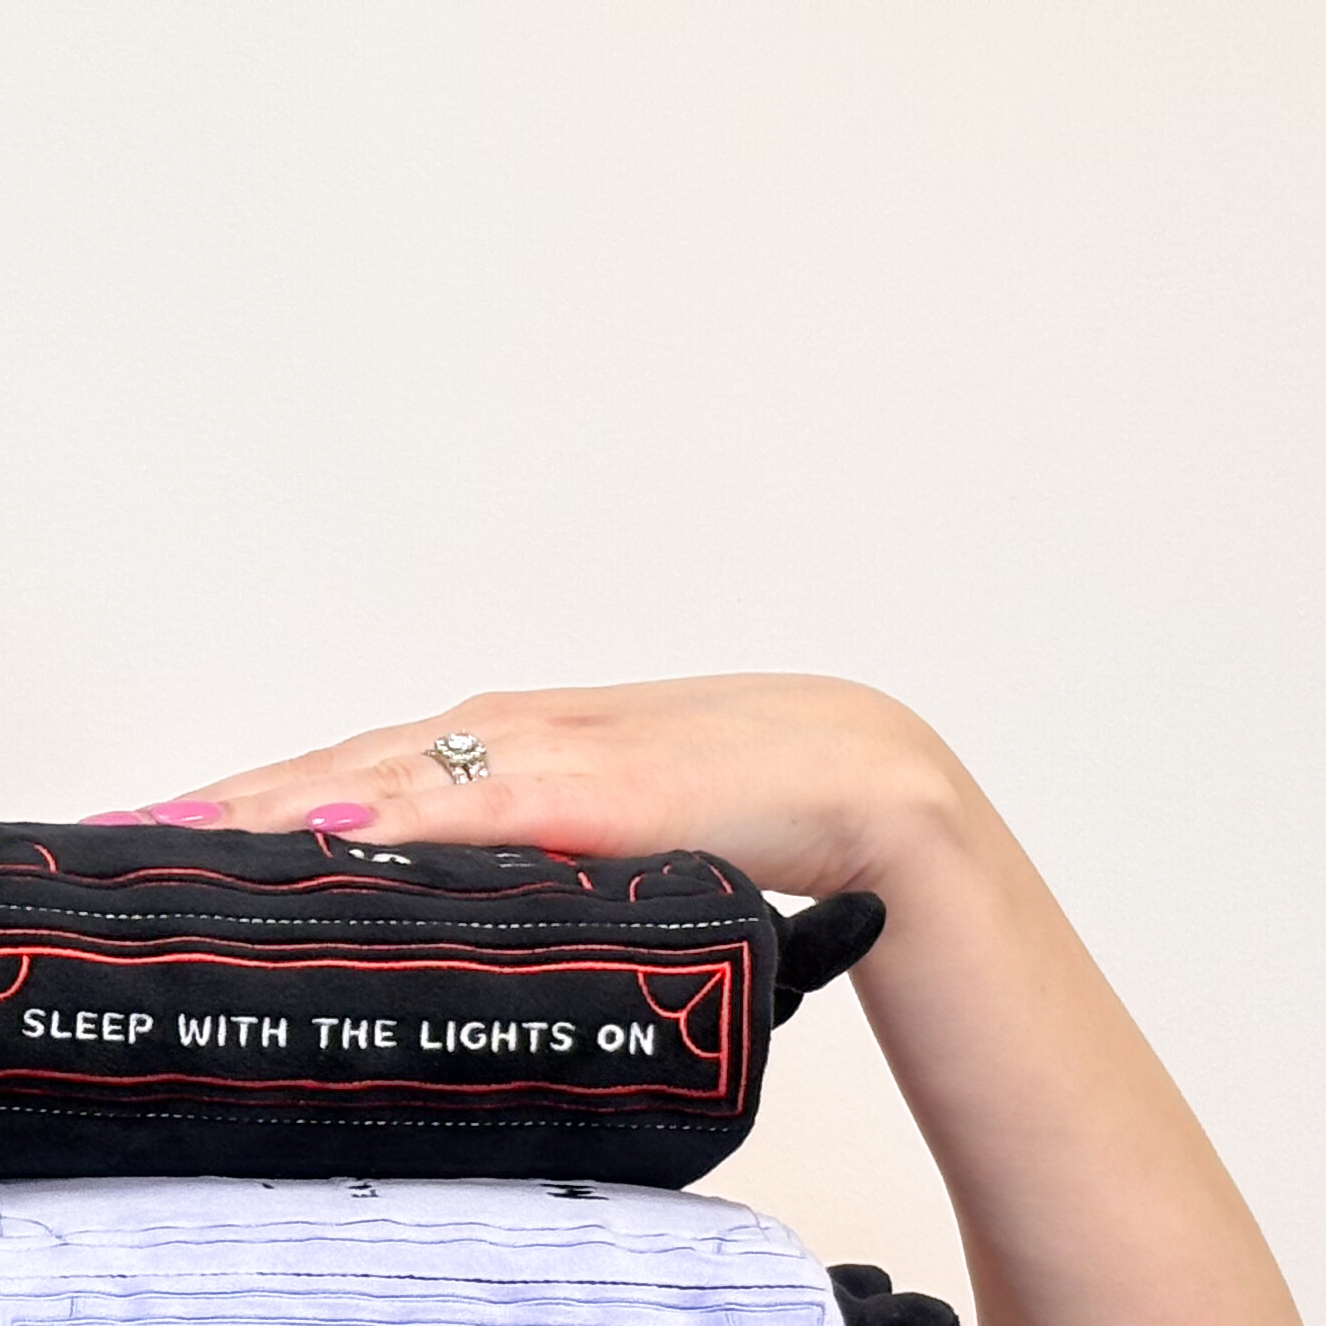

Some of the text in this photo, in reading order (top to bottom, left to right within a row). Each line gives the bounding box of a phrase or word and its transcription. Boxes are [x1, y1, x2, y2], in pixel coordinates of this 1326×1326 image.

[21, 1008, 657, 1058] SLEEP WITH THE LIGHTS ON
